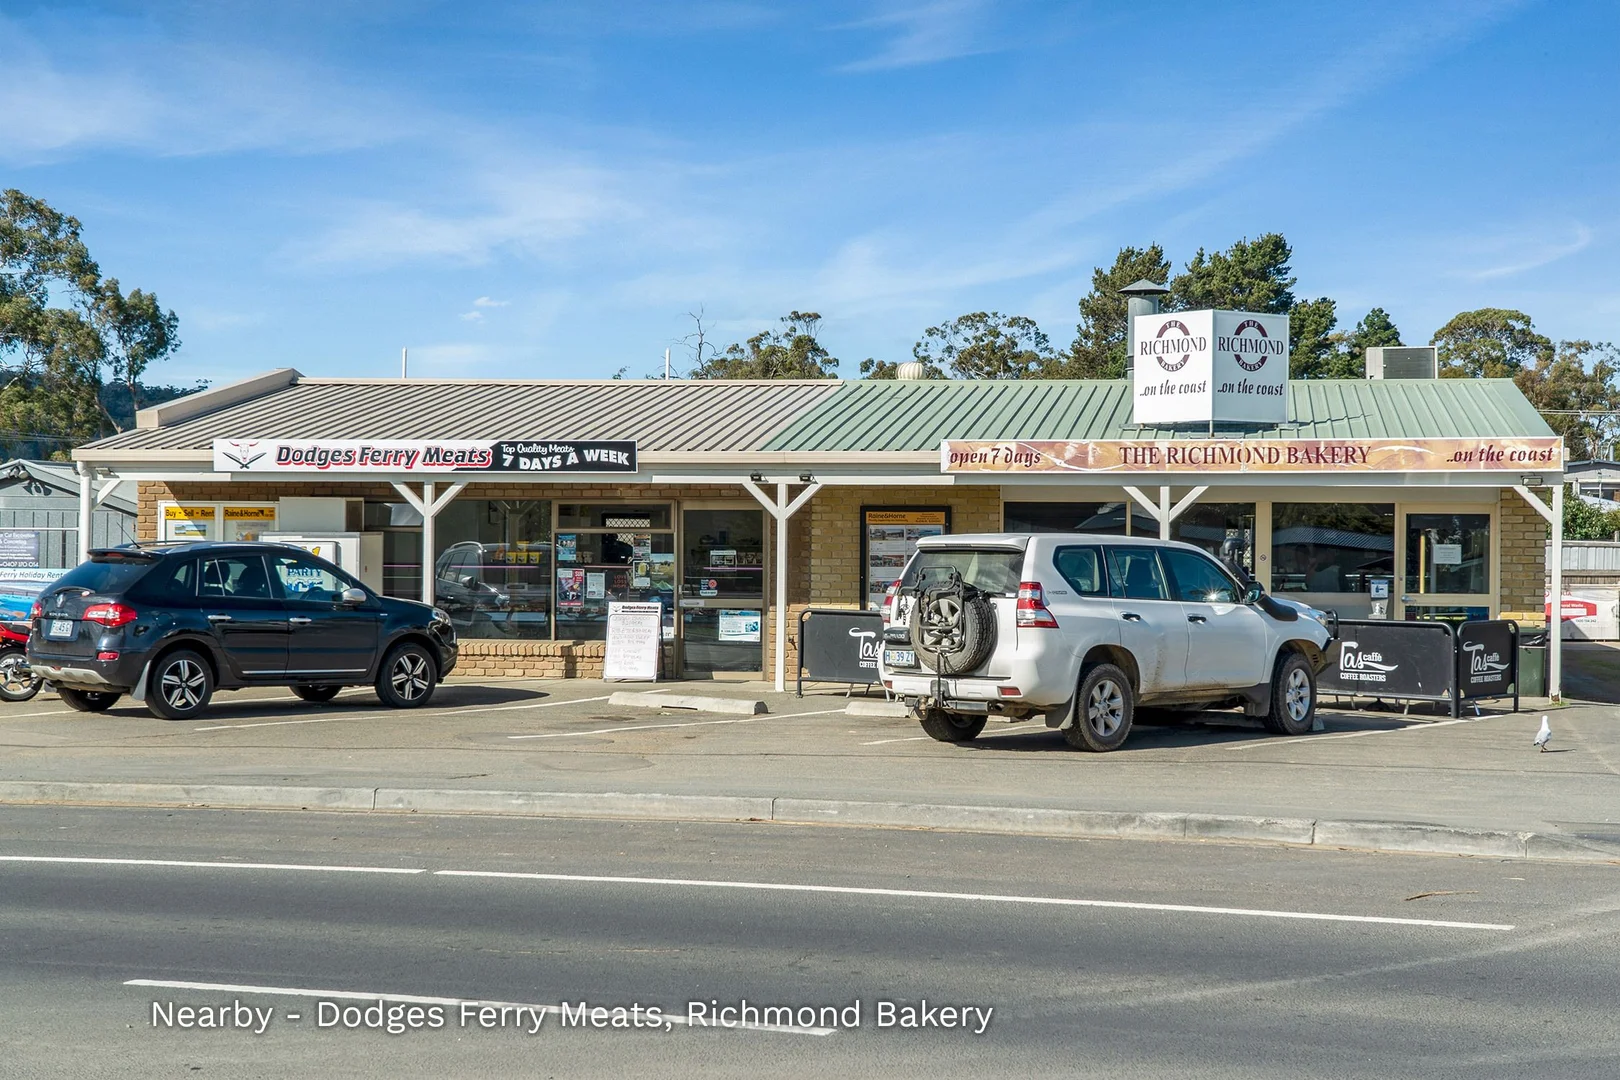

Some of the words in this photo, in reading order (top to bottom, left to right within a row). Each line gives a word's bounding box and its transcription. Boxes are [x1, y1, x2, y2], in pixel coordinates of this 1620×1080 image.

[1165, 320, 1181, 329] THE
[1244, 320, 1259, 329] THE
[1140, 336, 1207, 356] RICHMOND
[1218, 336, 1284, 356] RICHMOND
[1160, 360, 1185, 372] BAKERY
[1238, 360, 1263, 372] BAKERY
[1159, 379, 1176, 395] the
[1178, 380, 1207, 395] coast
[1238, 378, 1254, 394] the
[1256, 383, 1284, 396] coast
[500, 444, 516, 455] Top
[517, 443, 548, 456] Quality
[549, 444, 575, 454] Meats
[1119, 447, 1160, 465] THE
[1165, 446, 1280, 465] RICHMOND
[1286, 446, 1372, 464] BAKERY
[1478, 445, 1505, 463] the
[1509, 447, 1553, 462] coast
[275, 445, 356, 470] Dodges
[358, 445, 420, 469] Ferry
[422, 445, 493, 468] Meats
[502, 455, 514, 467] 7
[519, 455, 562, 471] DAYS
[566, 452, 580, 466] A
[583, 449, 630, 466] WEEK
[949, 450, 988, 468] open
[990, 447, 1001, 465] 7
[1004, 447, 1041, 468] days
[165, 509, 176, 518] Buy
[184, 509, 194, 517] Sell
[200, 509, 215, 517] Rent
[225, 509, 260, 517] Raine&Horne
[0, 571, 17, 579] Ferry
[19, 571, 46, 580] Holiday
[287, 568, 322, 577] PARTY
[849, 627, 880, 660] Tas
[896, 651, 905, 662] 39
[1340, 641, 1377, 671] Tas
[1462, 641, 1498, 675] Tas
[1340, 672, 1359, 680] COFFEE
[1359, 673, 1387, 682] ROASTERS
[1470, 675, 1484, 684] COFFEE
[1484, 674, 1502, 682] ROASTERS
